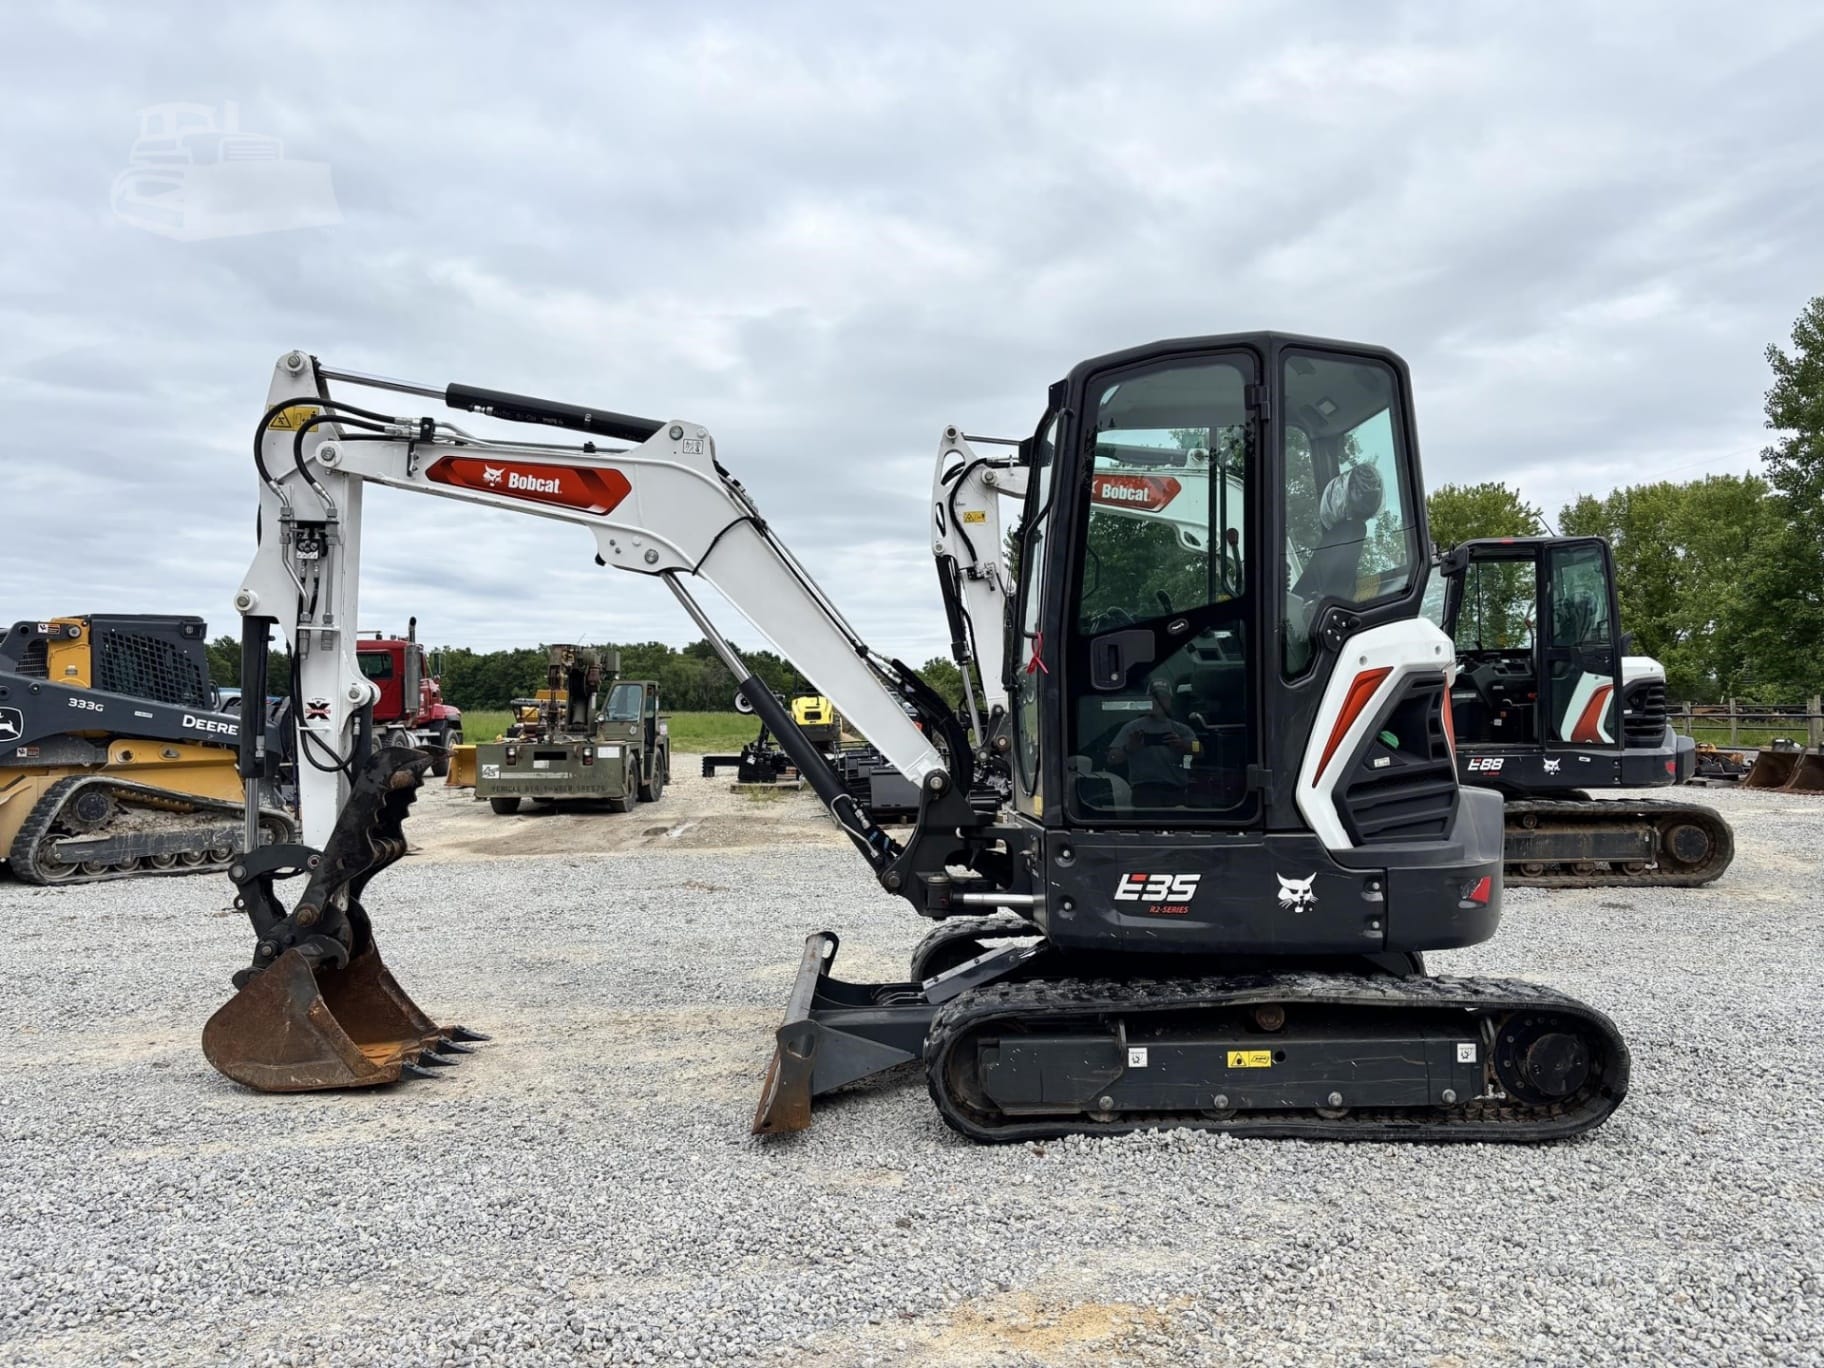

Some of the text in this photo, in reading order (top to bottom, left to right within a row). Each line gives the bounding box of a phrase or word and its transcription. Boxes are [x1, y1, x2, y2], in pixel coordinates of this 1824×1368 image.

[508, 472, 561, 494] Bobcat
[1102, 483, 1150, 502] Bobcat
[68, 697, 105, 713] 333G
[182, 714, 239, 736] DEERE
[1467, 758, 1505, 771] E88
[1113, 873, 1202, 902] E35
[1149, 905, 1190, 914] R2-SERIES
